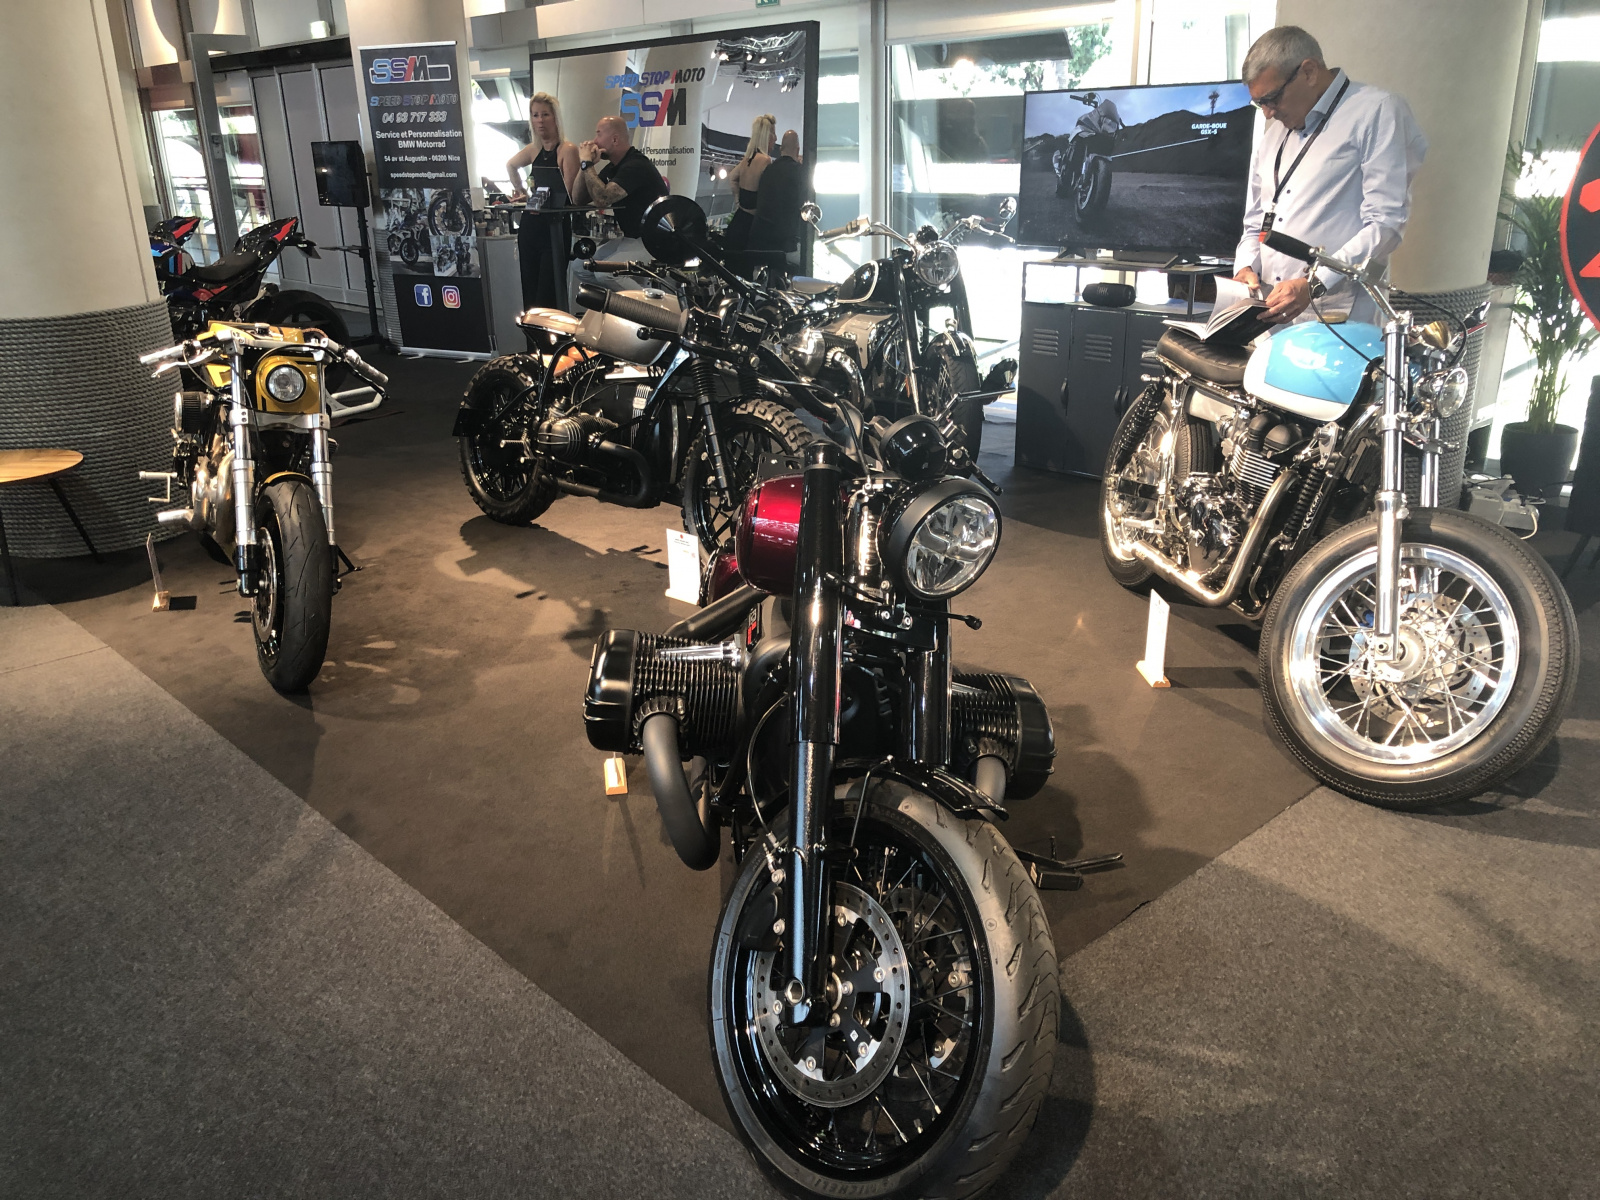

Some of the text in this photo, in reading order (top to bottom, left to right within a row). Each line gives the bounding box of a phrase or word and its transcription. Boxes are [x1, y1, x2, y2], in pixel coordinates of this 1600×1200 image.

[372, 55, 430, 84] SSM
[604, 67, 705, 89] SPEED STOP MOTO
[370, 94, 458, 106] SPEED STOP MOTO
[620, 88, 687, 129] SSM
[382, 112, 395, 124] 04
[410, 111, 427, 123] 717
[375, 129, 462, 139] Service et Personnalisation
[398, 140, 445, 149] BMW Motorrad
[646, 146, 694, 154] Personnalisation
[448, 154, 461, 162] Nice
